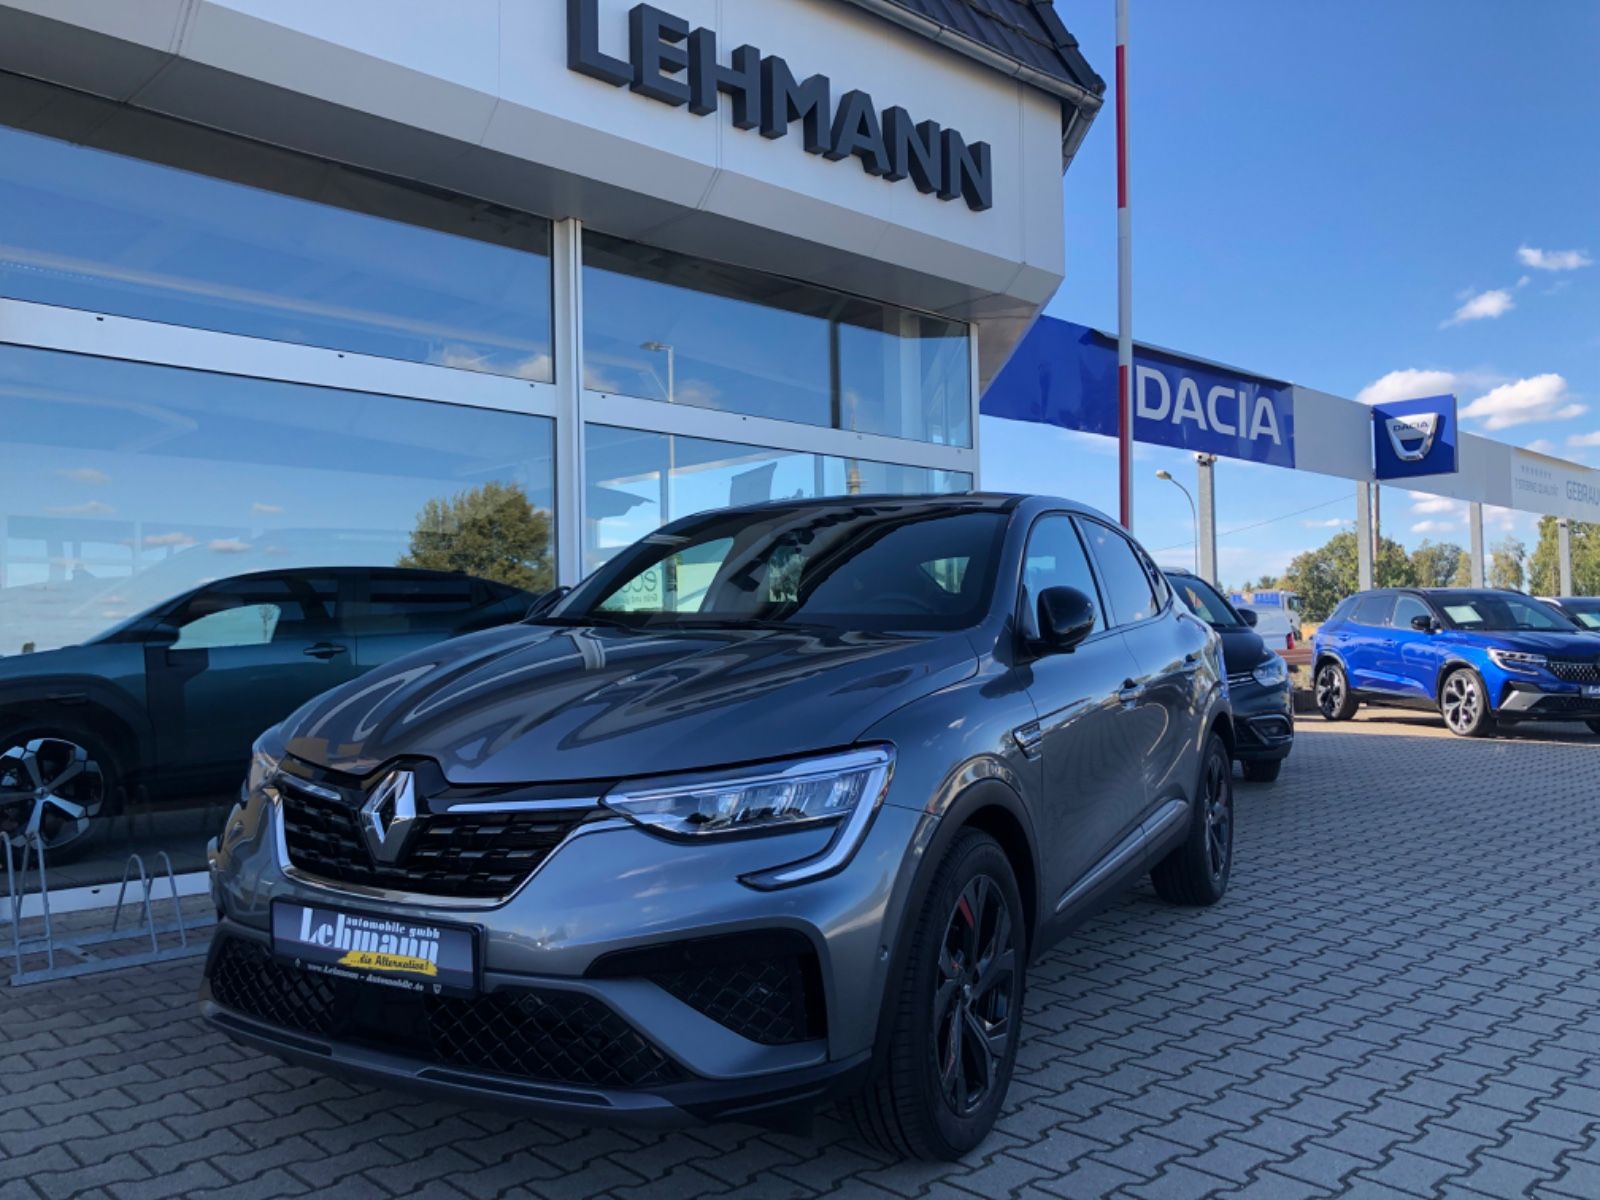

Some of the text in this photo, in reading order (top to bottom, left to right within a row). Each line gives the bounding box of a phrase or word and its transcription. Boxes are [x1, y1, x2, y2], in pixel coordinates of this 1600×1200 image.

[567, 0, 993, 211] LEHMANN
[1136, 365, 1281, 445] DACIA
[1393, 421, 1428, 432] DACIA
[300, 907, 439, 966] Lehmann
[346, 917, 440, 939] automobile gmbh
